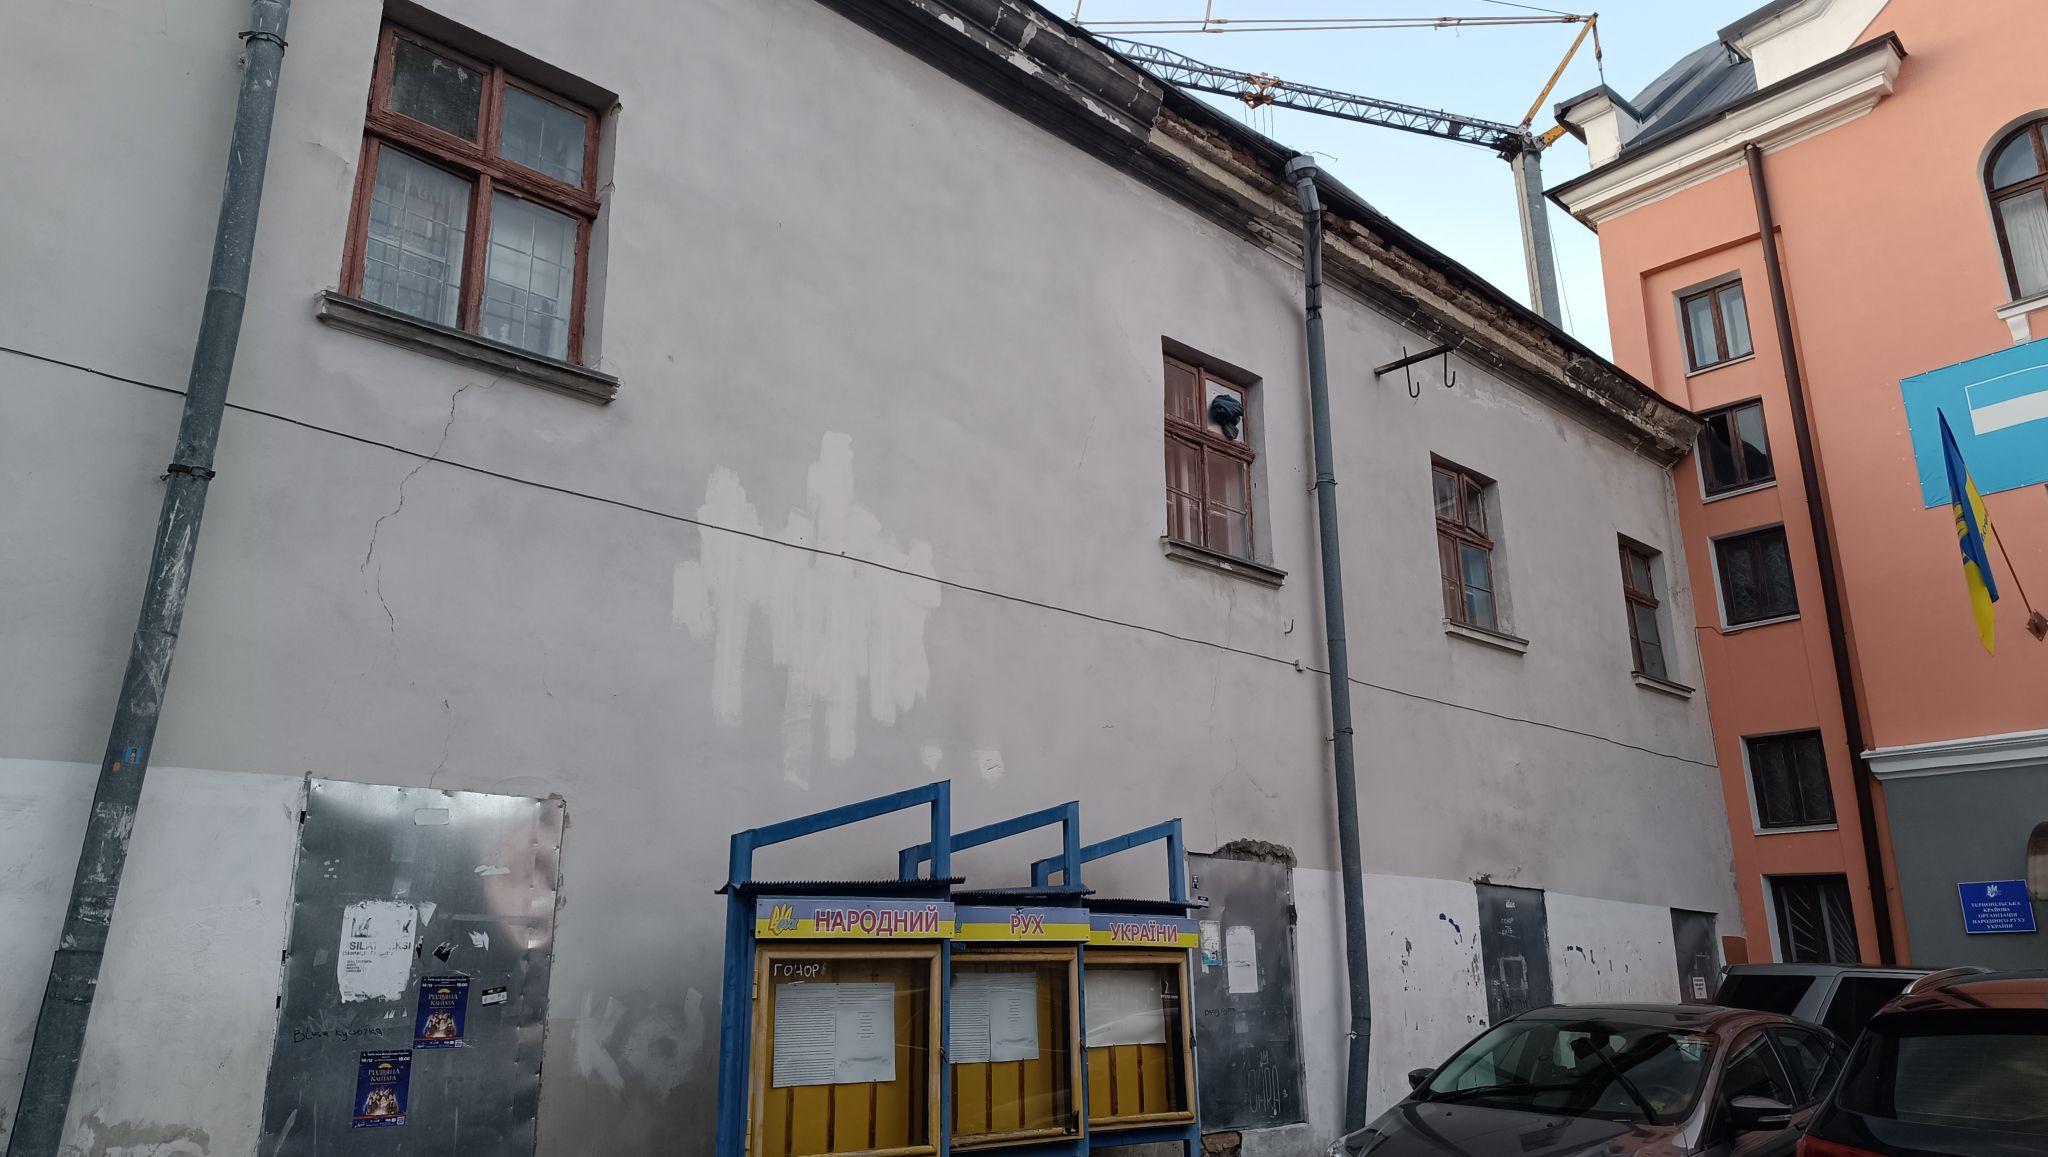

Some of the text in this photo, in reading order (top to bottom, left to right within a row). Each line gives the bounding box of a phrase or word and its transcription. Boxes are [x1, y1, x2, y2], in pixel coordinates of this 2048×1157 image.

[815, 905, 1178, 943] НАРОДНИЙ РУХ УКРАЇНИ
